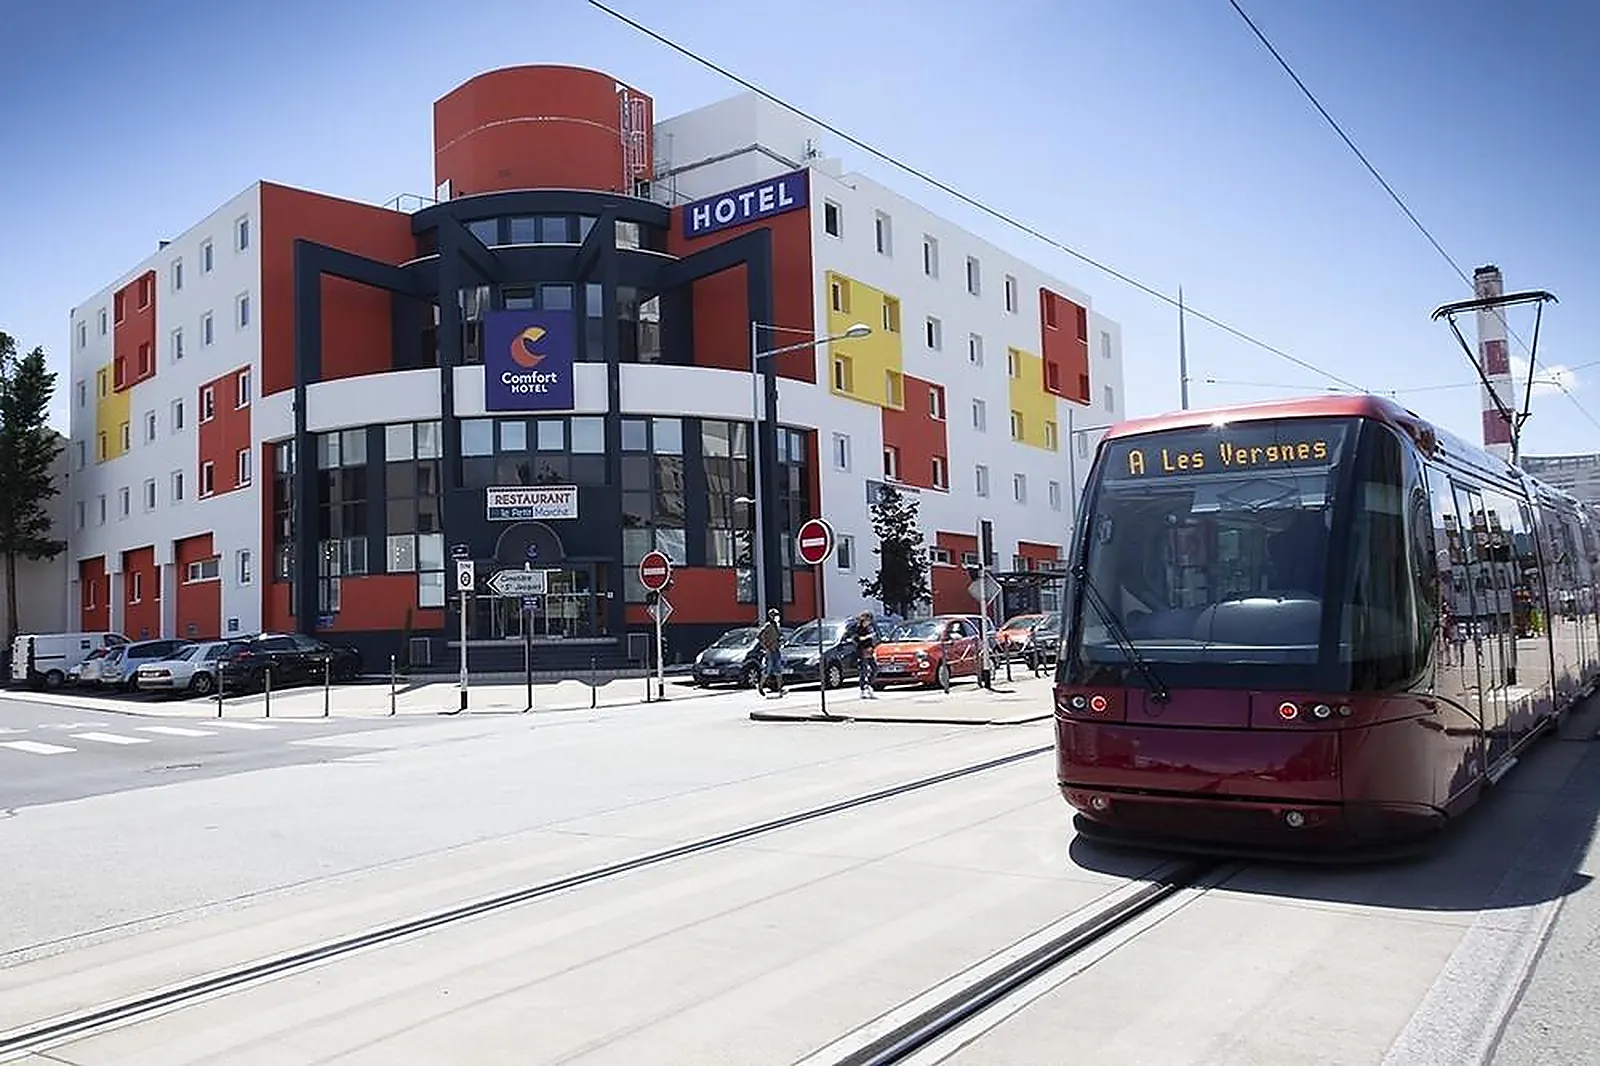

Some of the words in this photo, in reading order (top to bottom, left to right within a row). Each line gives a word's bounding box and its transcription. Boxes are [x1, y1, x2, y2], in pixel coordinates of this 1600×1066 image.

[693, 182, 793, 231] HOTEL
[501, 371, 557, 384] Comfort
[511, 384, 548, 393] HOTEL
[1128, 450, 1145, 475] A
[1162, 449, 1205, 471] Les
[495, 493, 571, 505] RESTAURANT
